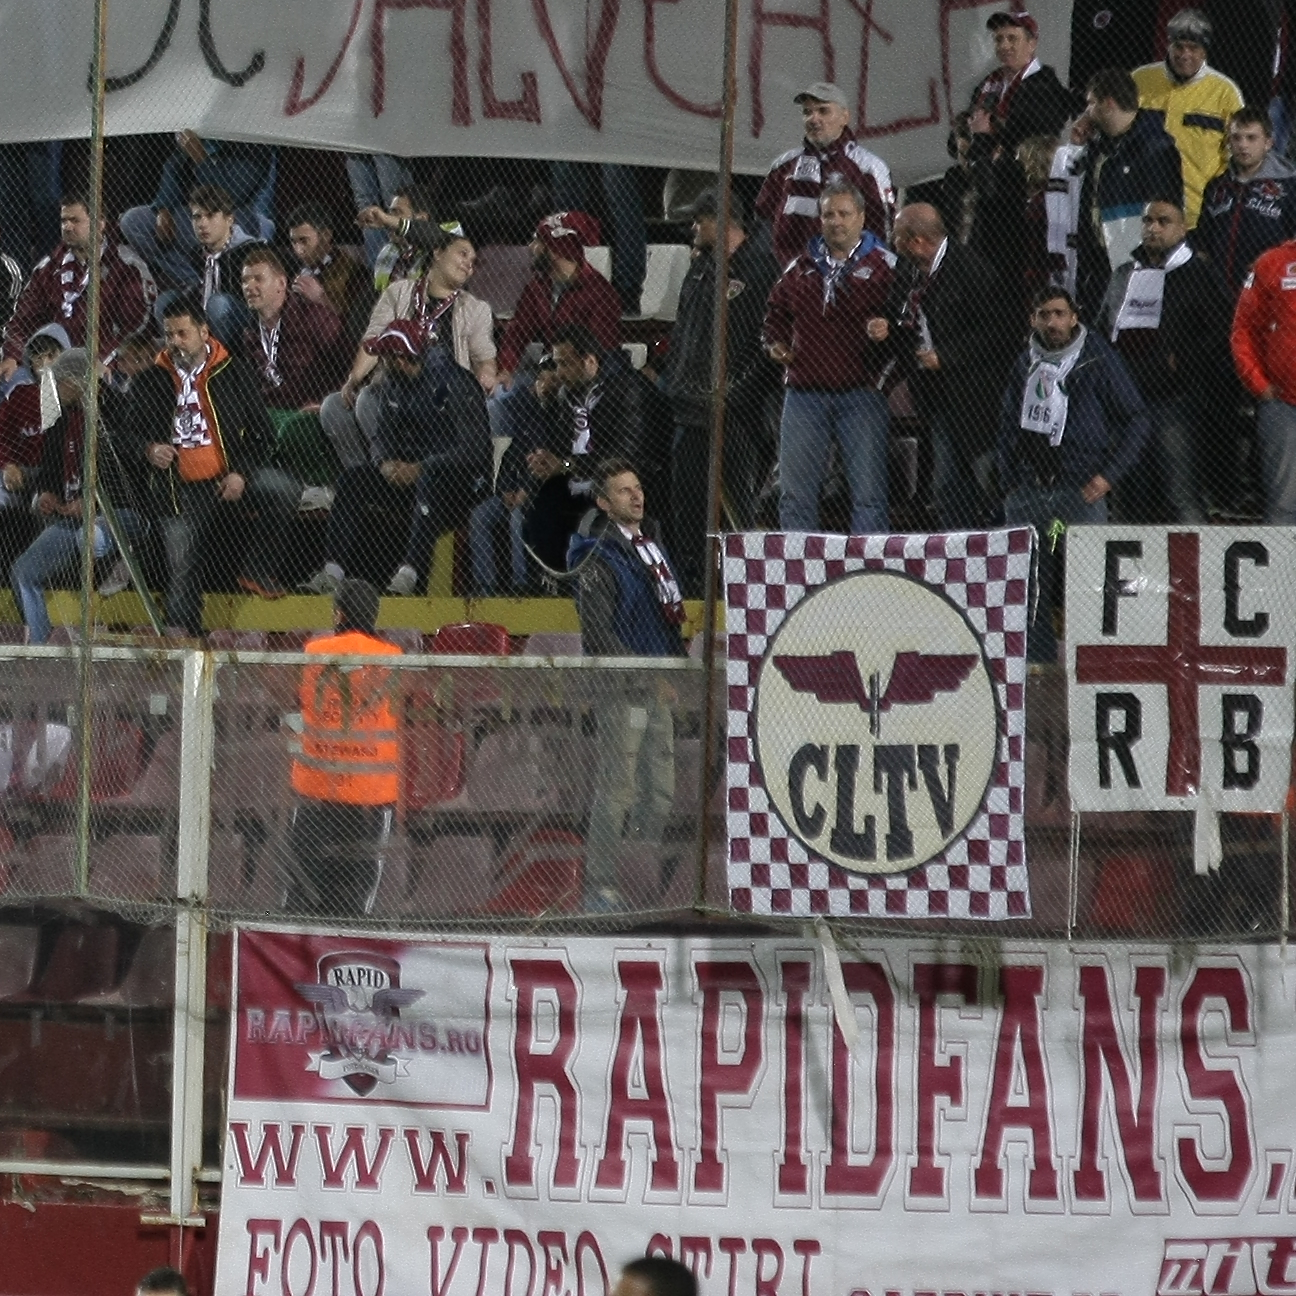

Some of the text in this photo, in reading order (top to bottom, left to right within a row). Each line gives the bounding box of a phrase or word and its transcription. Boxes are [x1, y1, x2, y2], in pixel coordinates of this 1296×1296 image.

[1102, 541, 1270, 638] F C
[1096, 692, 1264, 790] R B
[788, 743, 960, 862] CLTV
[332, 966, 385, 989] RAPID
[247, 1218, 821, 1296] FOTO VIDEO TIRI
